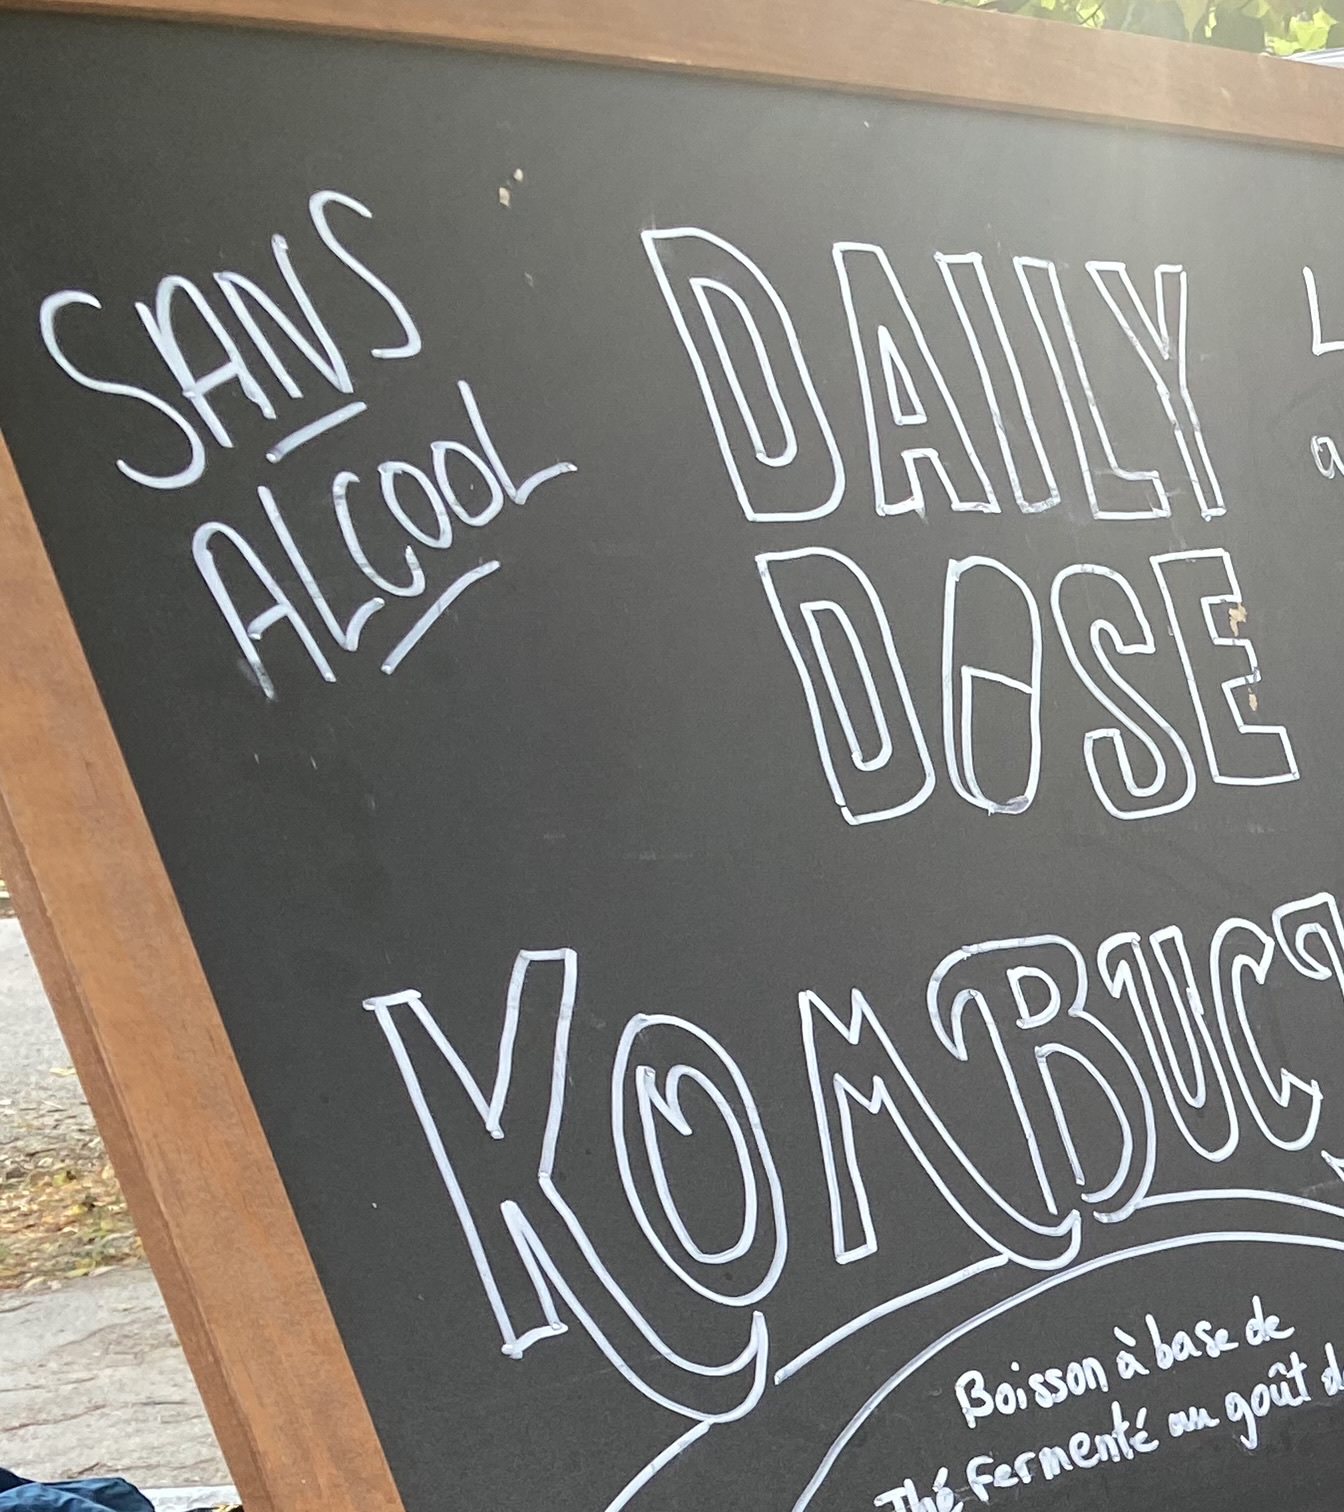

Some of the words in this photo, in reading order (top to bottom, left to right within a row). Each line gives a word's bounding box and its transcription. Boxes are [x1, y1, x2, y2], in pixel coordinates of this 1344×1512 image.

[40, 190, 422, 488] SANS
[641, 227, 1226, 523] DAILY
[191, 380, 578, 701] ALCOOL
[756, 546, 1300, 825] DOSE
[955, 1362, 1109, 1428] Boisson
[1115, 1326, 1149, 1379] à
[1144, 1314, 1240, 1370] base
[1245, 1295, 1295, 1347] de
[1225, 1351, 1311, 1451] goût
